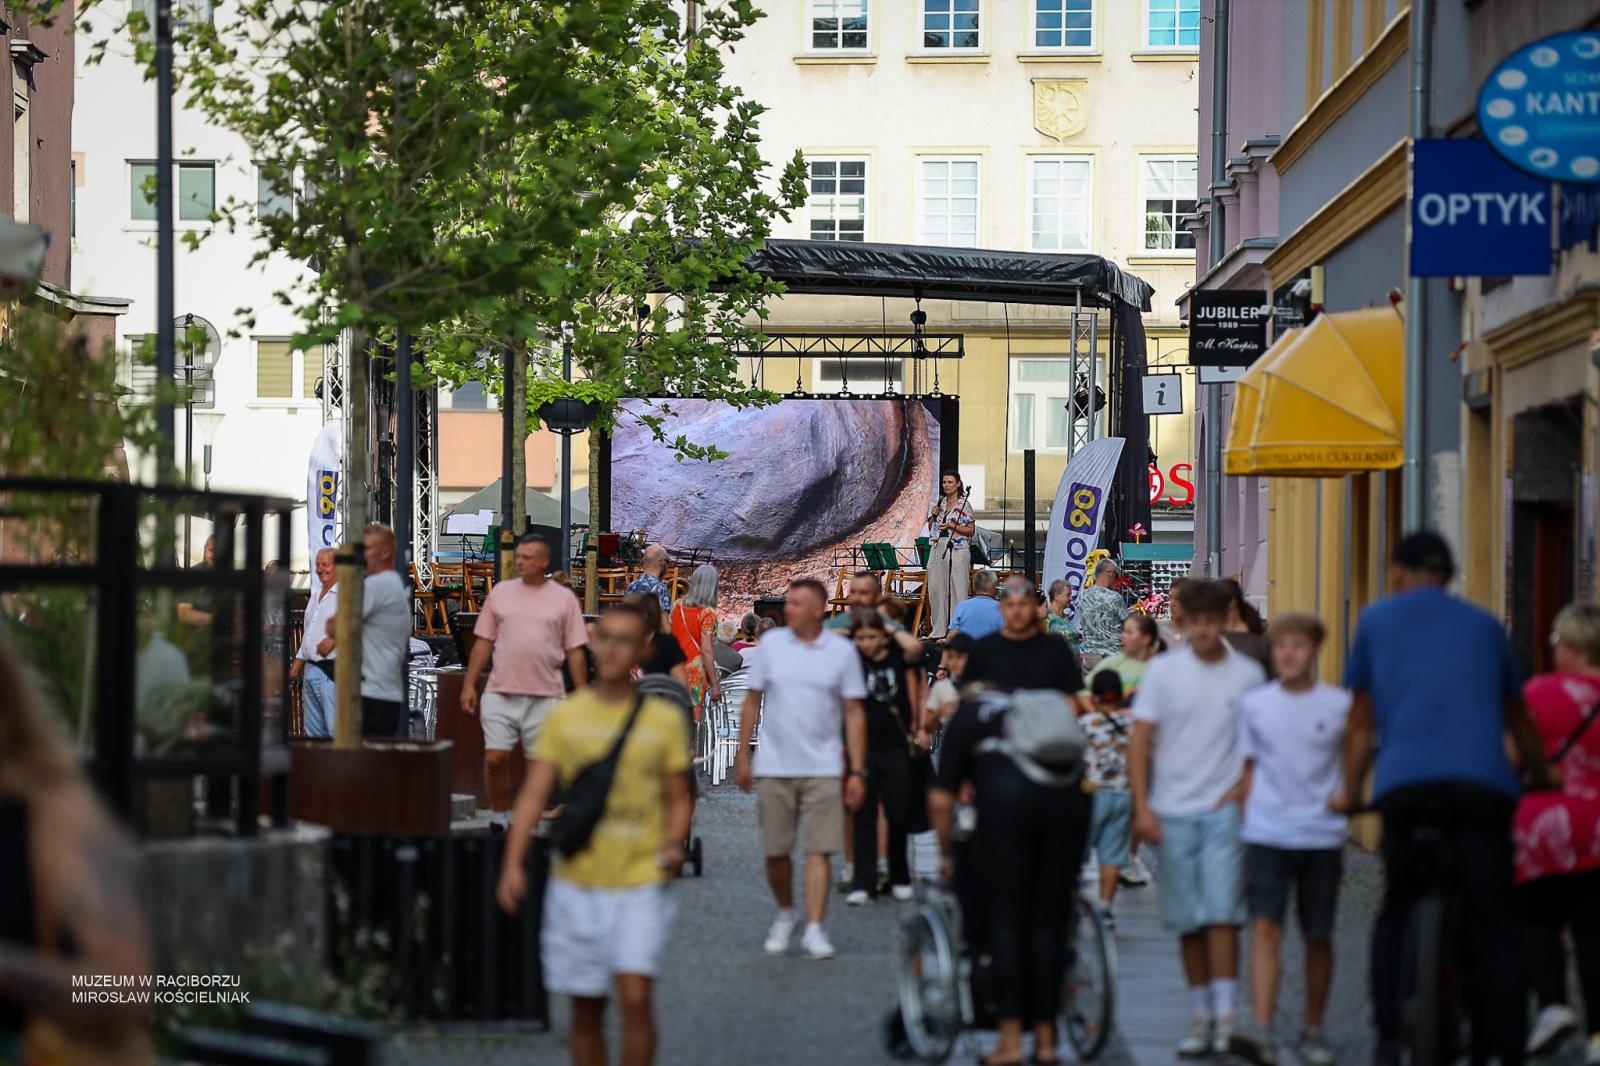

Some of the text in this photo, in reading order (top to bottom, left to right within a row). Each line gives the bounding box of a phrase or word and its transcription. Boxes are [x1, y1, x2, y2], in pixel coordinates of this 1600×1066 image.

[1418, 193, 1546, 226] OPTYK
[1196, 306, 1259, 319] JUBILER
[1218, 321, 1239, 329] 1989
[320, 475, 336, 515] 90
[1070, 489, 1096, 528] 90
